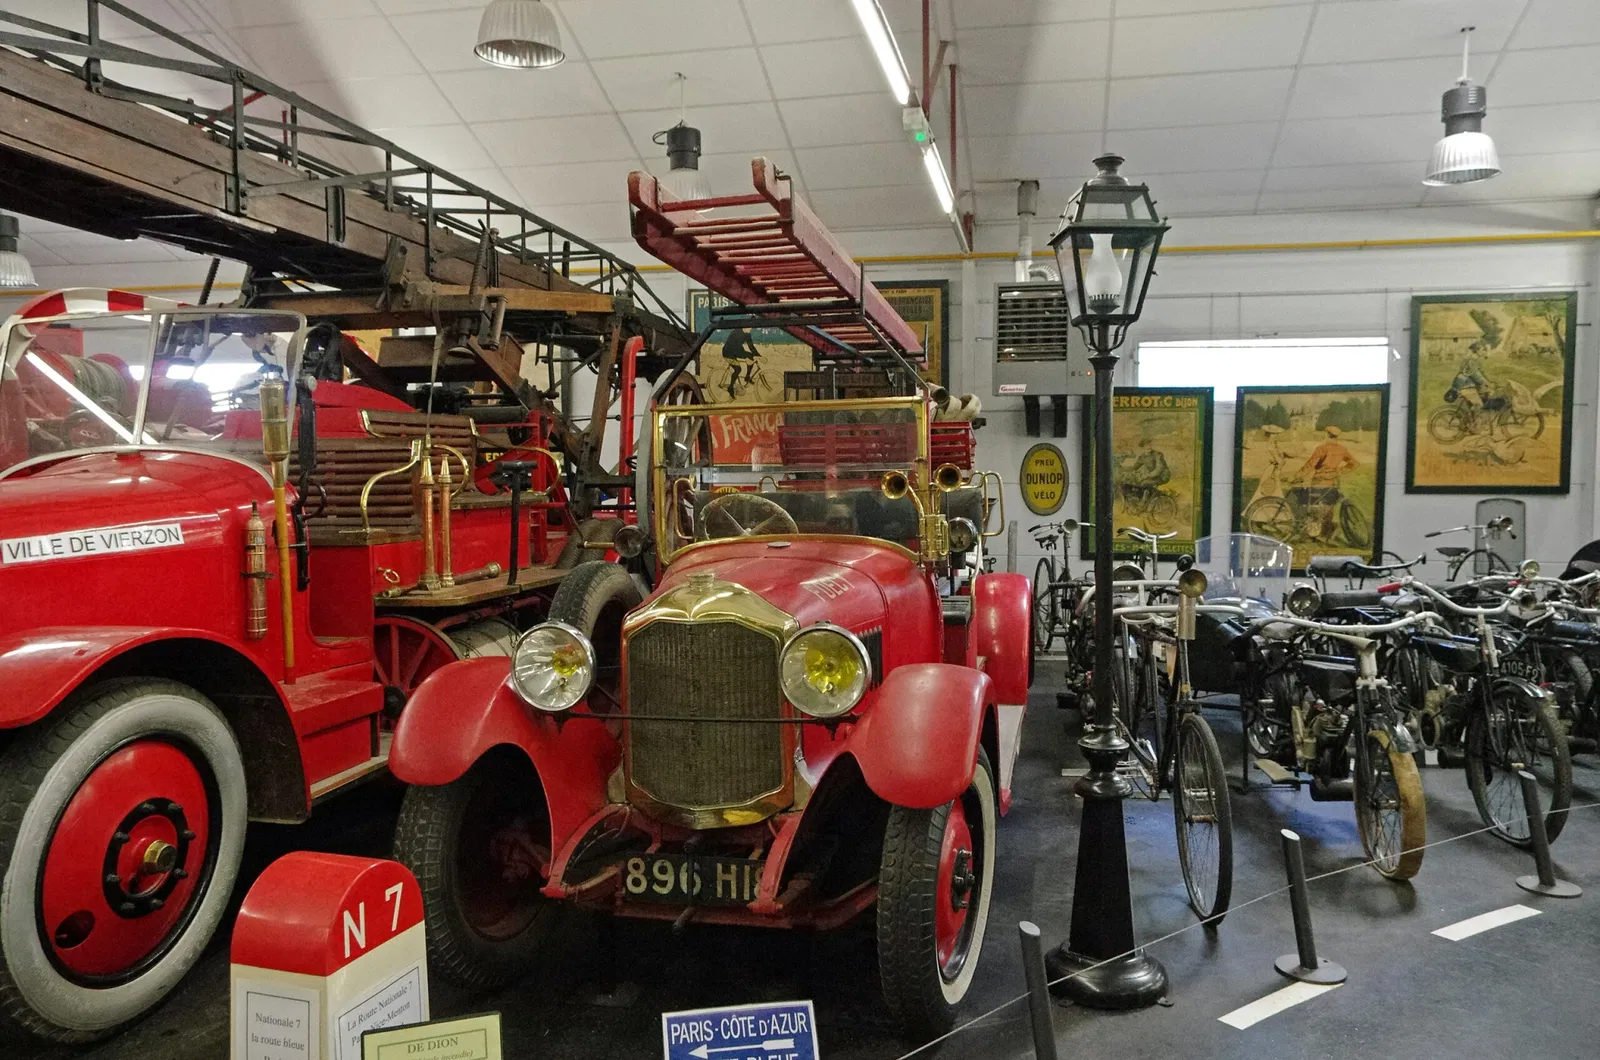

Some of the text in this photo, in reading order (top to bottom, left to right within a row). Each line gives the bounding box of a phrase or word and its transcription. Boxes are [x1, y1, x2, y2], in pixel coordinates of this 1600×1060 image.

[1034, 459, 1055, 467] PNEU
[1026, 472, 1063, 485] DUNLOP
[7, 526, 181, 560] VILLE DE VIERZON
[626, 857, 702, 896] 896
[343, 881, 404, 959] N 7
[347, 980, 413, 1032] La Route Nationale 7
[255, 1012, 301, 1029] Nationale 7
[671, 1020, 714, 1045] PARIS
[720, 1014, 757, 1039] CÔTE
[251, 1032, 305, 1051] la route bleue
[407, 1036, 459, 1054] DE DION
